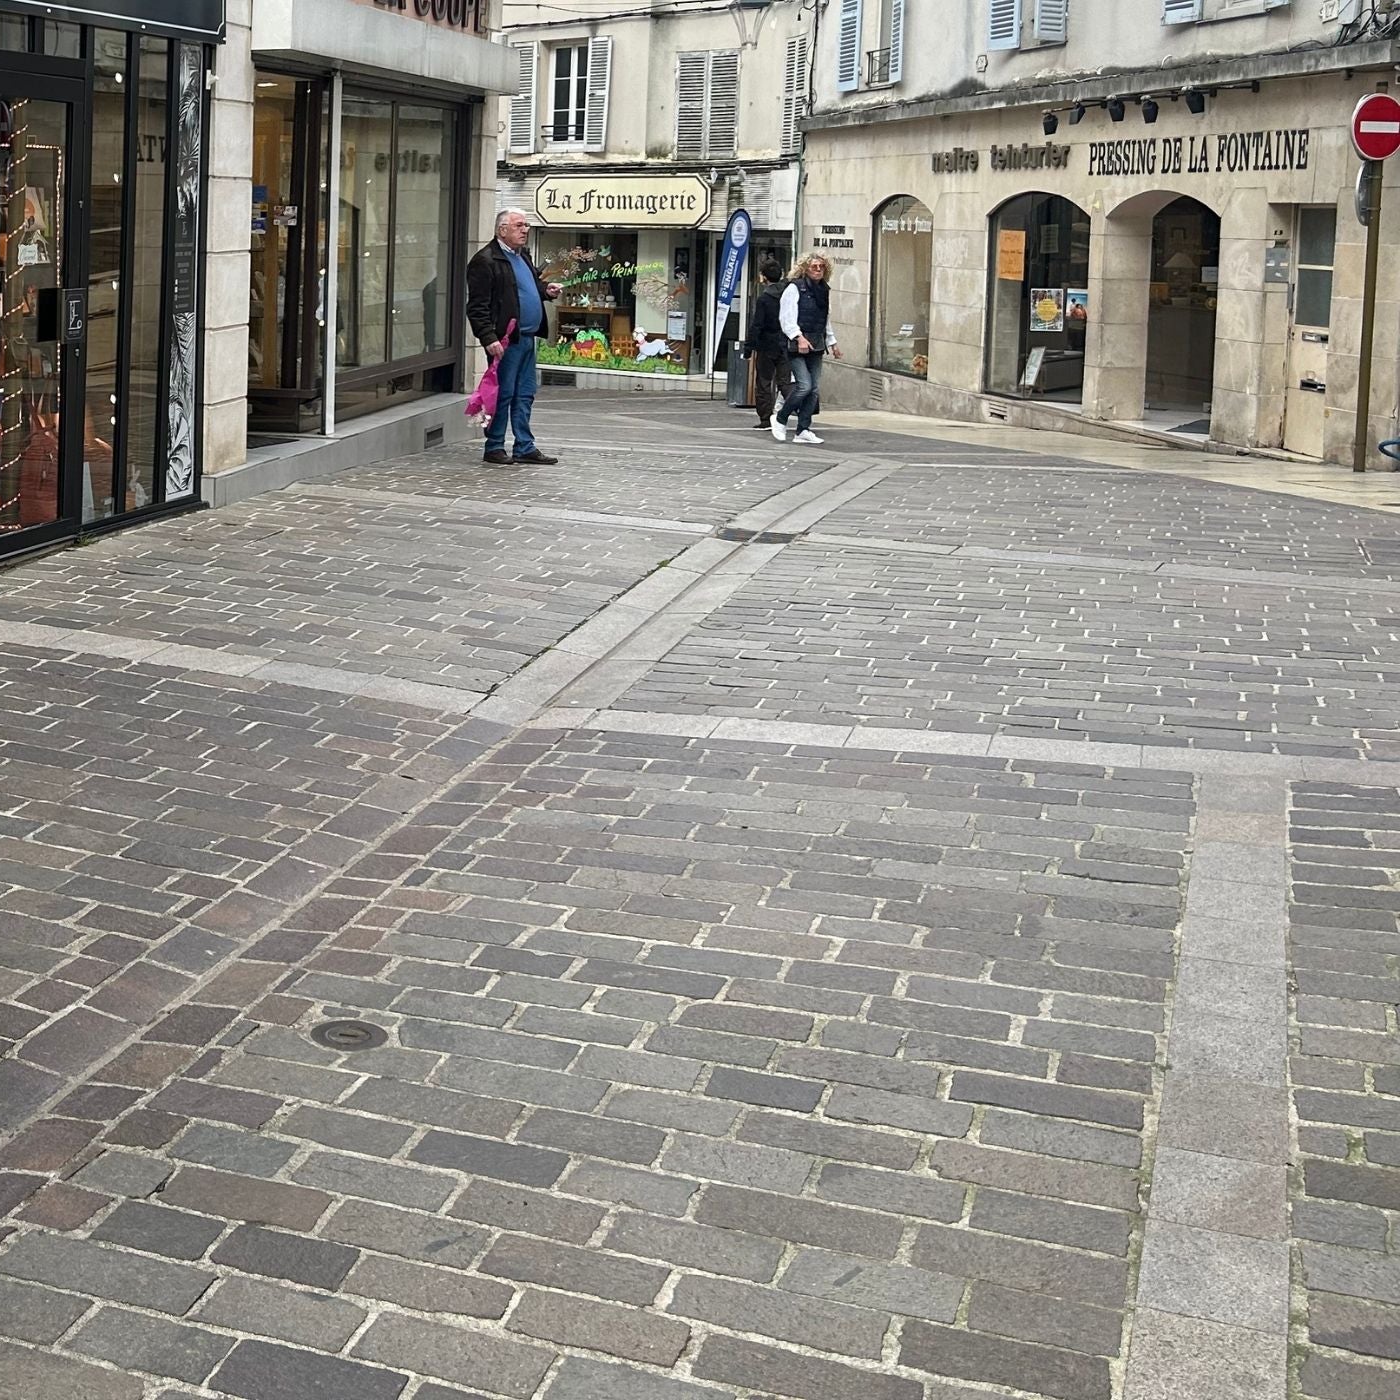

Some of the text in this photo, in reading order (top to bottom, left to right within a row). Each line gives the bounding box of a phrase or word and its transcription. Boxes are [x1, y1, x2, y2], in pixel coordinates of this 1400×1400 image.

[990, 141, 1071, 170] teinturier
[1088, 129, 1310, 176] PRESSING DE LA FONTAINE
[545, 188, 697, 215] La Fromagerie
